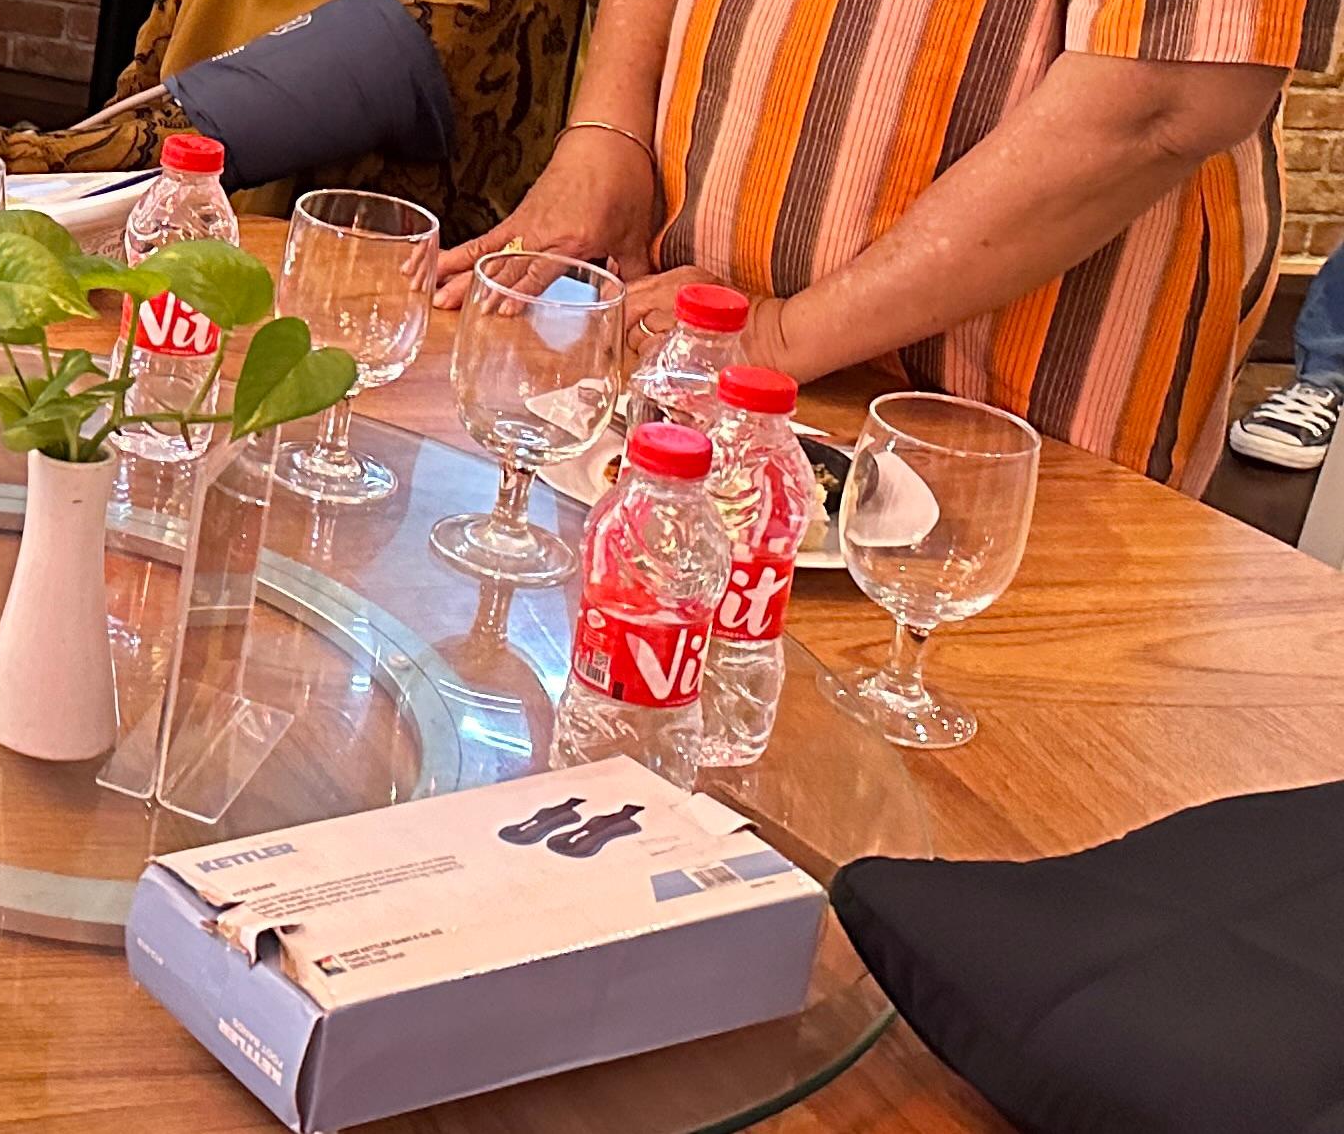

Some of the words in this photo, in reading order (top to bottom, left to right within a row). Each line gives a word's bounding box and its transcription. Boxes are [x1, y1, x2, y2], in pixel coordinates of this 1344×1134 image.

[719, 566, 789, 637] it
[625, 628, 703, 700] Vi
[195, 842, 298, 873] KETTLER
[218, 1017, 283, 1087] KETTLER
